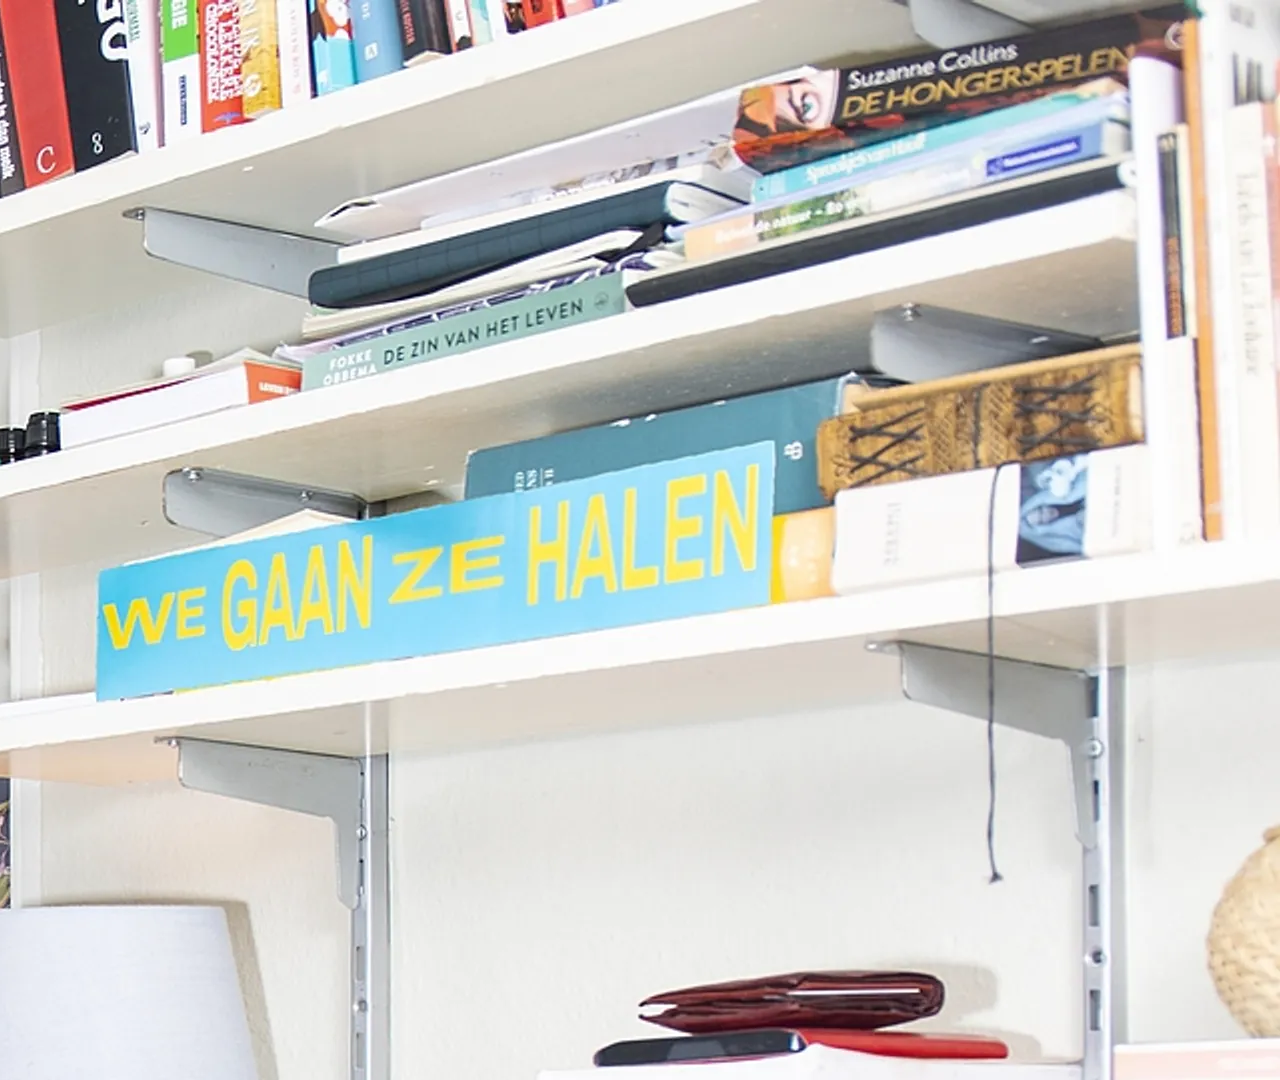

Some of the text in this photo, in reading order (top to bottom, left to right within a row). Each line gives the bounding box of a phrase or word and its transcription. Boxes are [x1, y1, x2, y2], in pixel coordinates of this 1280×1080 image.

[842, 46, 1135, 119] DE HONGERSPELEN
[845, 43, 1019, 91] Suzanne Collins
[0, 145, 16, 179] melk
[383, 299, 584, 365] DE ZIN VAN HET LEVEN
[322, 363, 377, 387] OBBEMA
[329, 349, 373, 371] FOKKE
[102, 465, 758, 650] WE GAAN ZE HALEN
